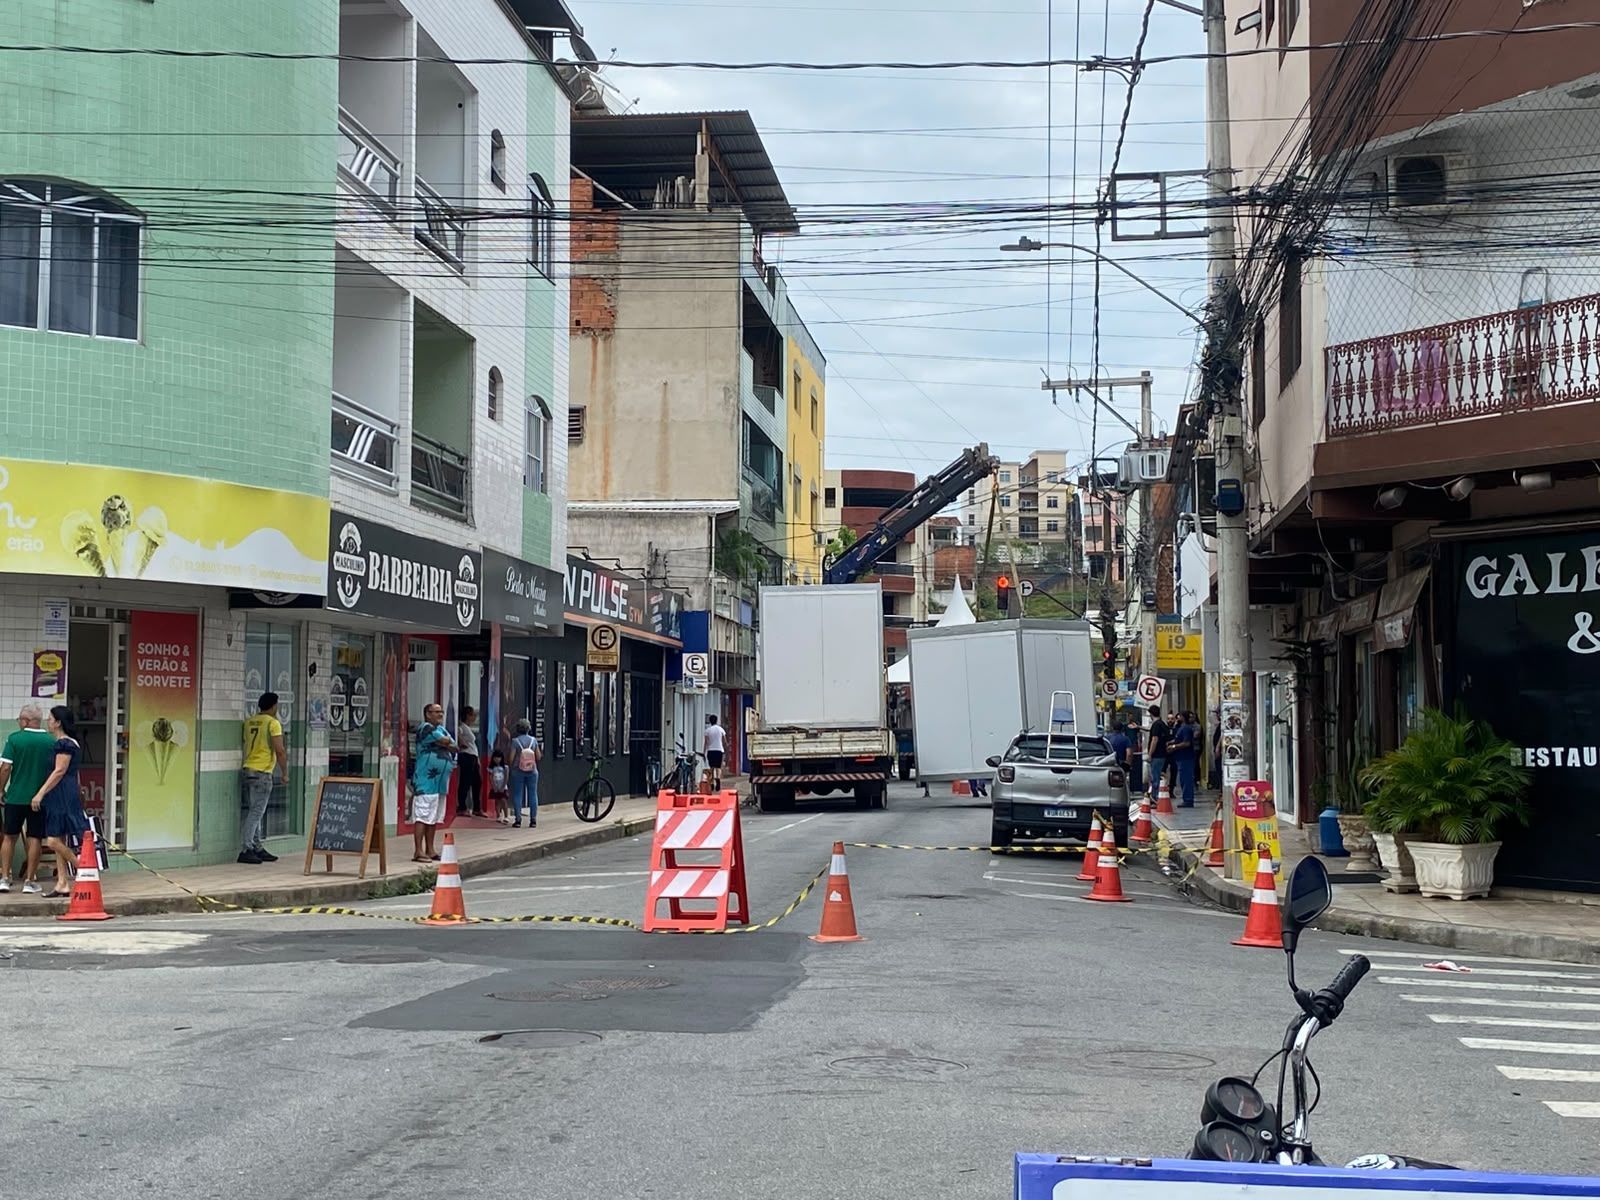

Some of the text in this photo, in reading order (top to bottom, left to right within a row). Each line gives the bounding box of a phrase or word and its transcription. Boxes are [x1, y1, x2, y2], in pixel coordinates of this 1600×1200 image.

[367, 550, 453, 605] BARBEARIA
[579, 568, 629, 621] PULSE
[599, 629, 609, 647] E
[137, 642, 190, 656] SONHO &
[137, 656, 188, 673] VERÃO &
[690, 657, 700, 671] E
[136, 675, 191, 689] SORVETE
[1145, 682, 1156, 696] E
[250, 727, 259, 750] 7
[1263, 832, 1278, 840] TEM
